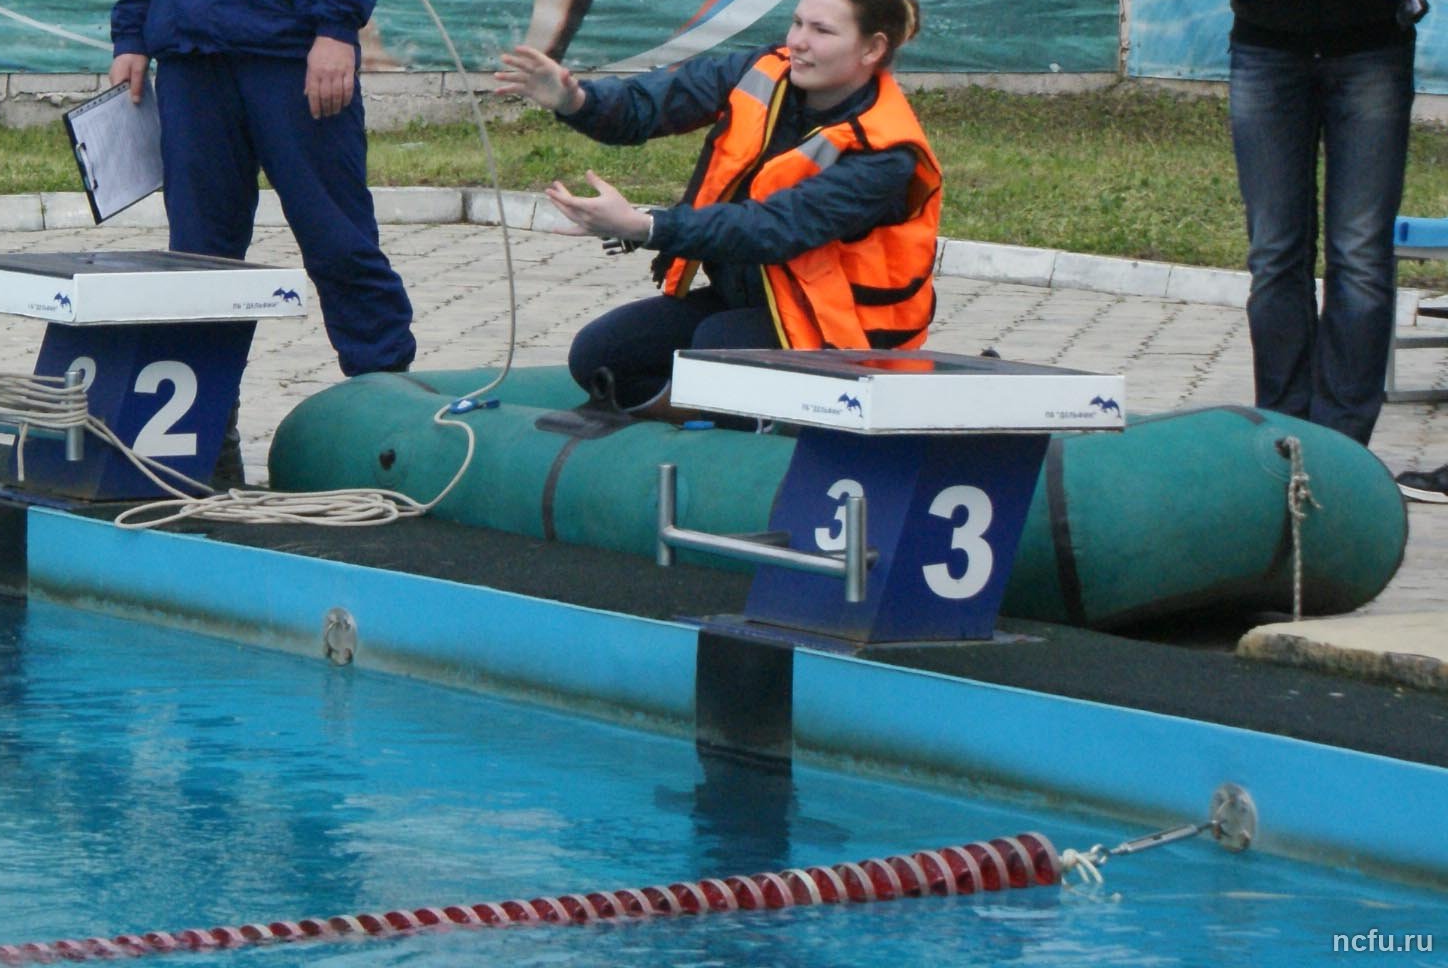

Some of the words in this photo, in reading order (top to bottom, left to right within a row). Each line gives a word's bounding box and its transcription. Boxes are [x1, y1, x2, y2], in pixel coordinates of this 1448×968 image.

[132, 360, 198, 457] 2
[814, 478, 865, 551] 3
[922, 485, 993, 599] 3
